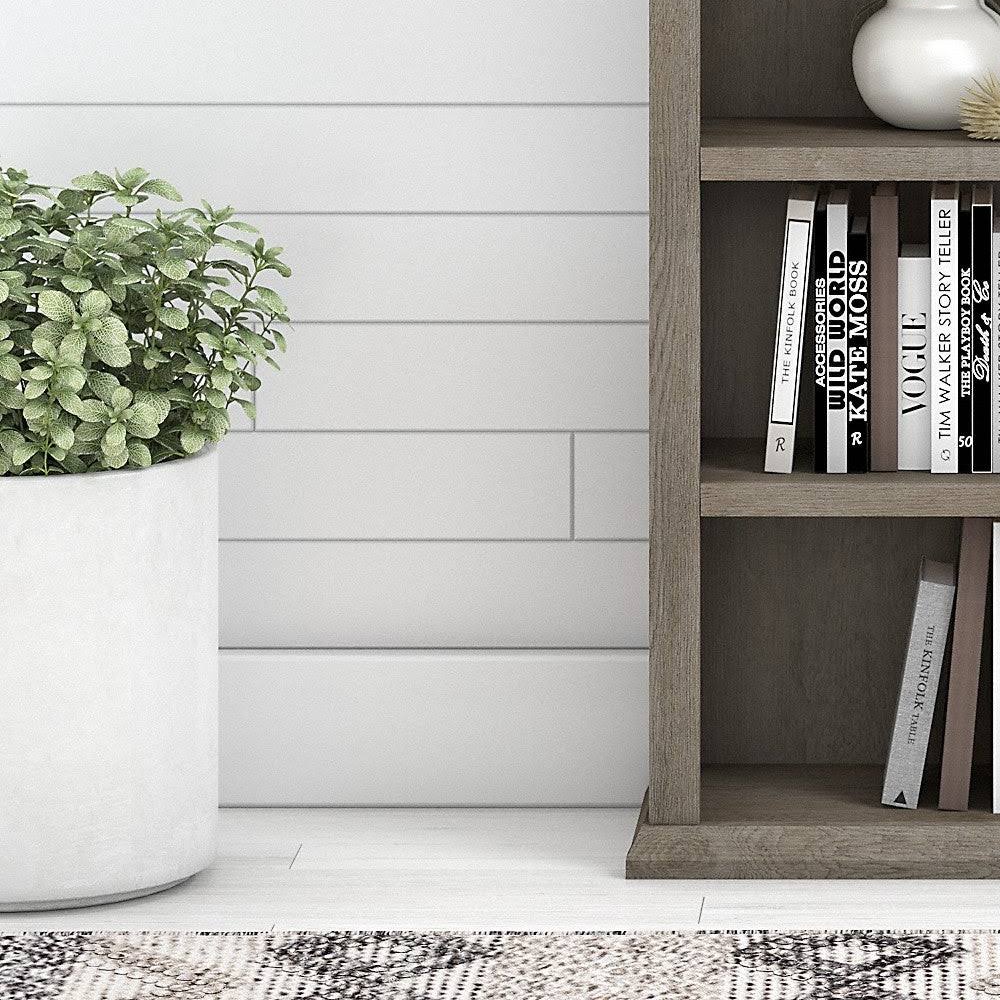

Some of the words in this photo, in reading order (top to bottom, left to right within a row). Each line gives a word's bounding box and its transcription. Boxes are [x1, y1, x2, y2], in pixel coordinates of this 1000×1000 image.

[938, 209, 951, 266] TELLER
[788, 261, 800, 297] BOOK
[829, 250, 846, 340] WORLD
[849, 260, 868, 339] MOSS
[938, 271, 951, 327] STORY
[960, 267, 971, 306] BOOK
[973, 279, 990, 304] Co
[783, 302, 797, 356] KINFOLK
[815, 277, 826, 388] ACCESSORIES
[960, 307, 971, 369] PLAYBOY
[973, 325, 990, 383] Death
[781, 358, 791, 384] THE
[829, 349, 846, 411] WILD
[849, 346, 868, 422] KATE
[901, 312, 927, 415] VOGUE
[938, 333, 951, 404] WALKER
[960, 370, 971, 398] THE
[938, 411, 951, 439] TIM
[958, 435, 973, 448] 50
[925, 625, 935, 646] THE
[913, 649, 933, 711] KINFOLK
[907, 713, 920, 745] TABLE
